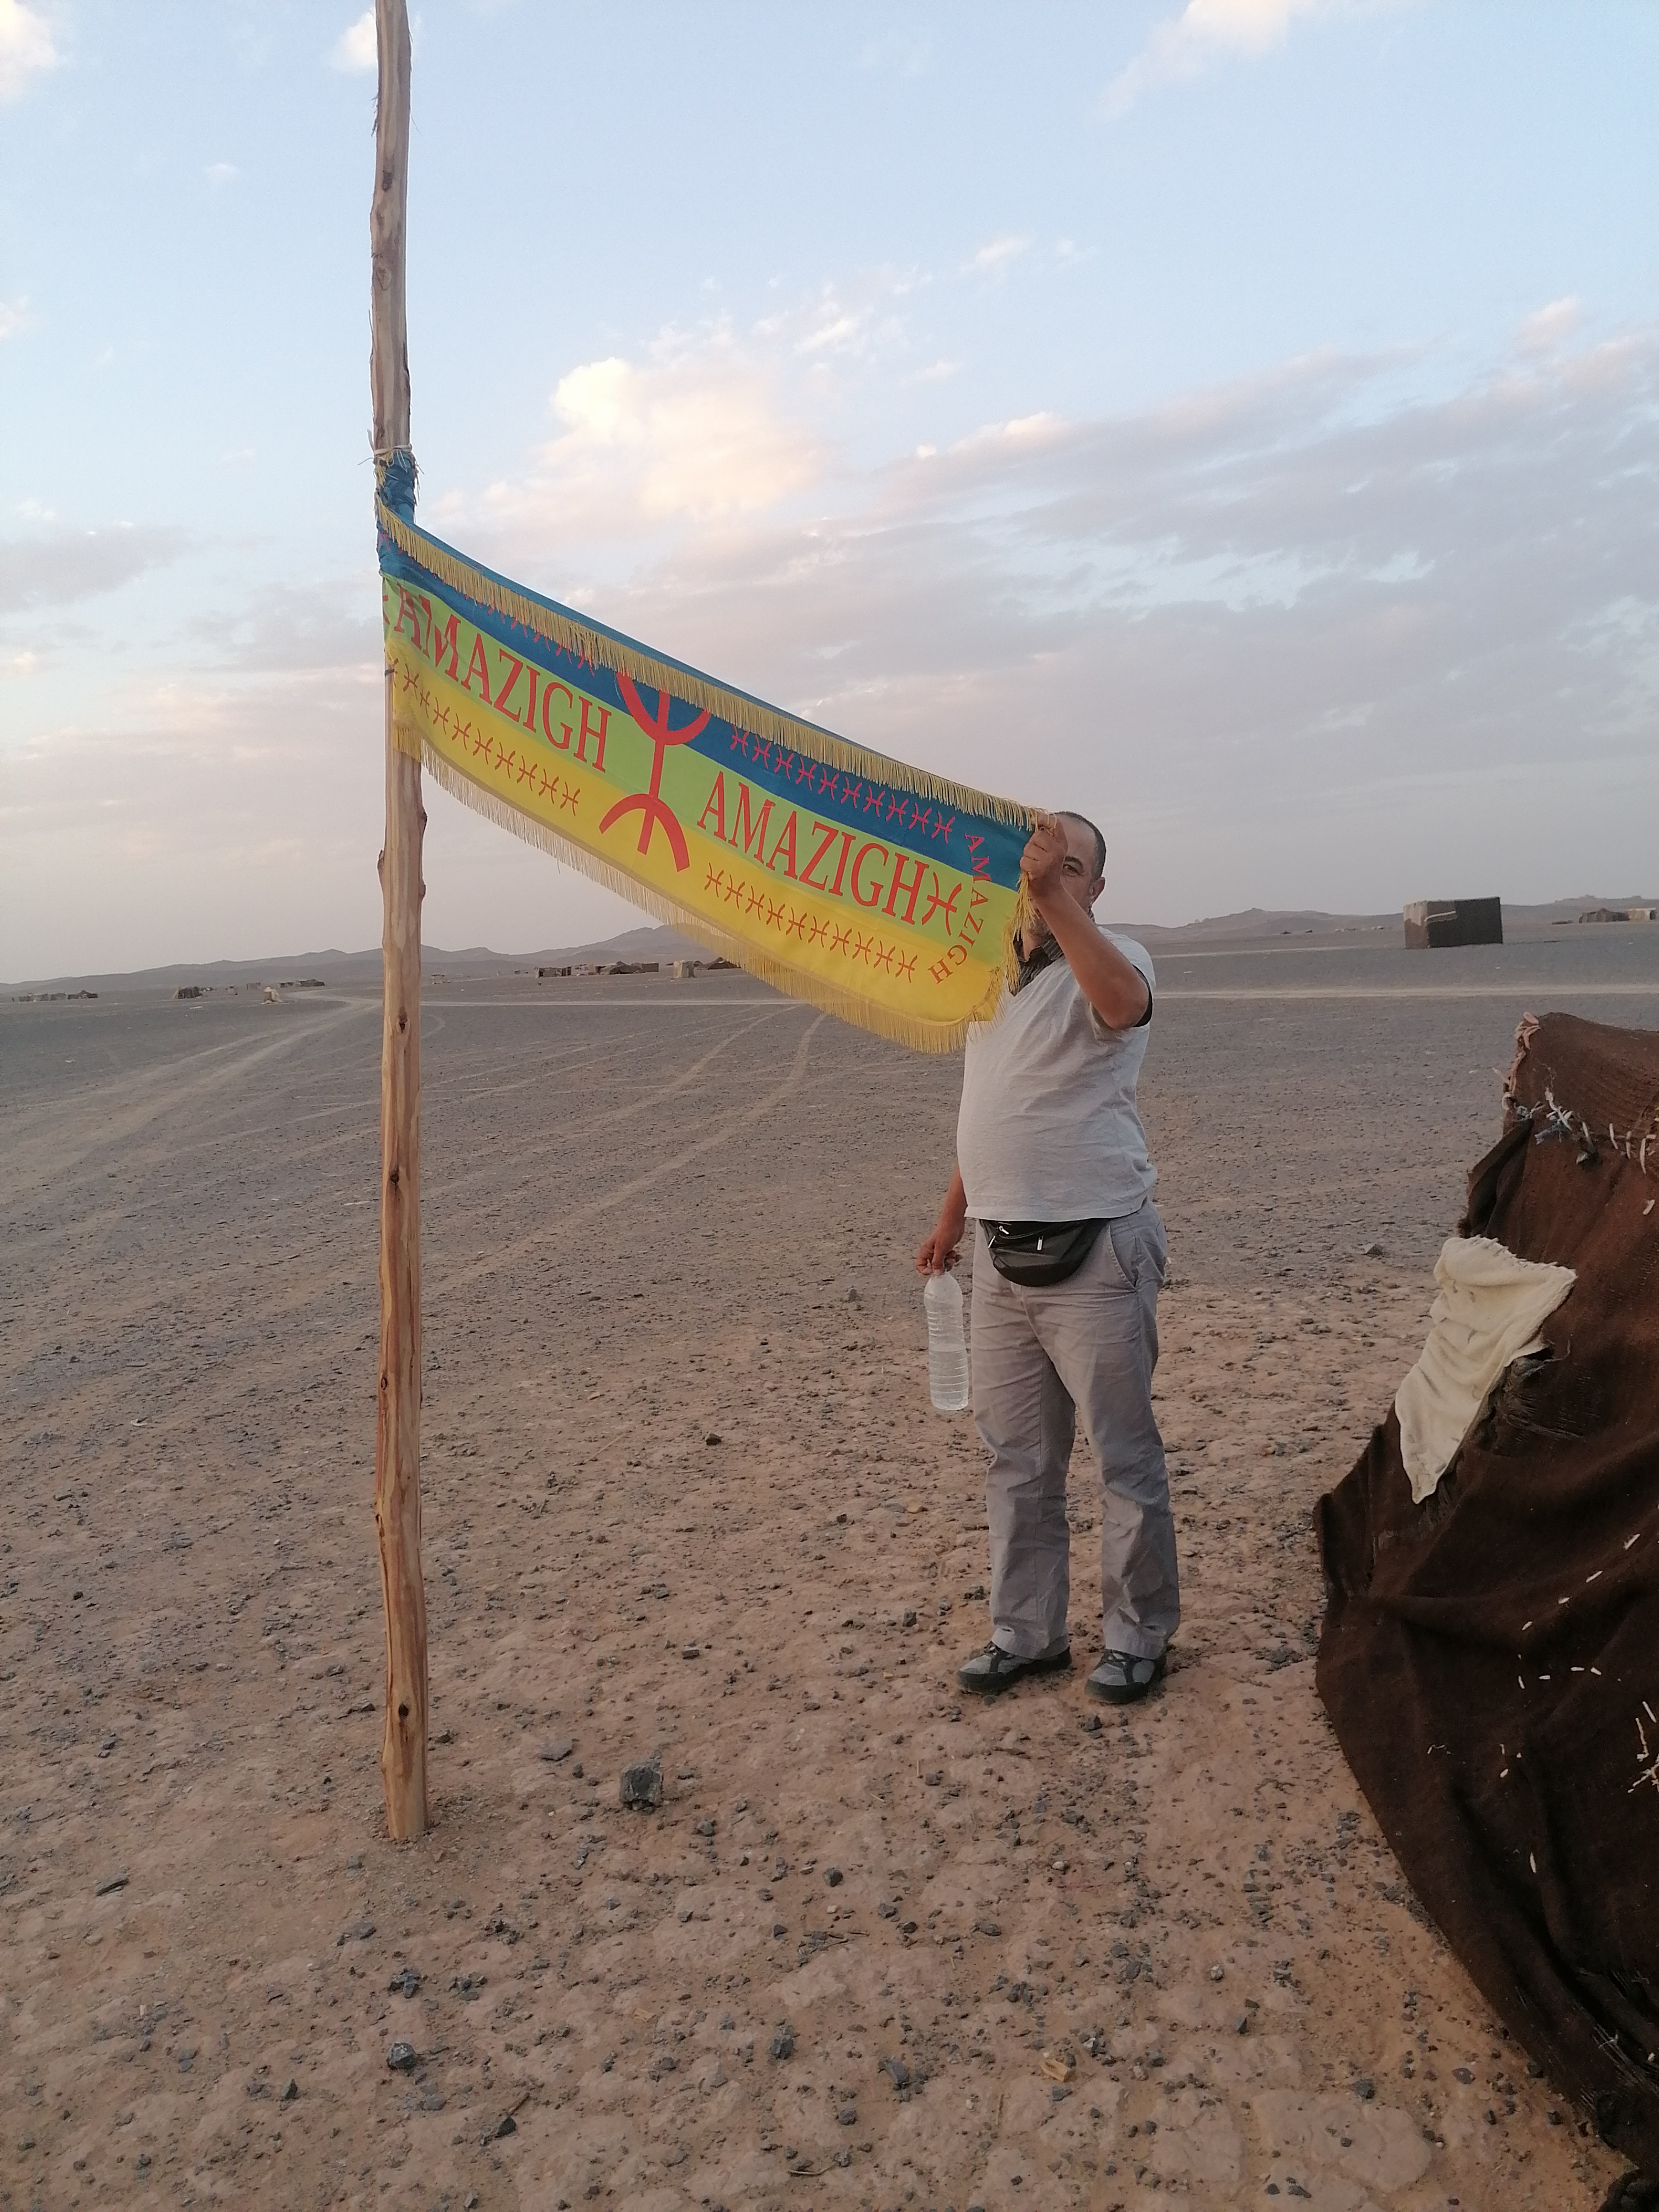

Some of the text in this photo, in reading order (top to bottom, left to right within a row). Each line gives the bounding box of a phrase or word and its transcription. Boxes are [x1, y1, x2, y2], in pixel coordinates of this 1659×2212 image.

[394, 582, 612, 774] AMAZIGH
[697, 771, 928, 925] AMAZIGH
[926, 832, 992, 985] AMAZIGH
